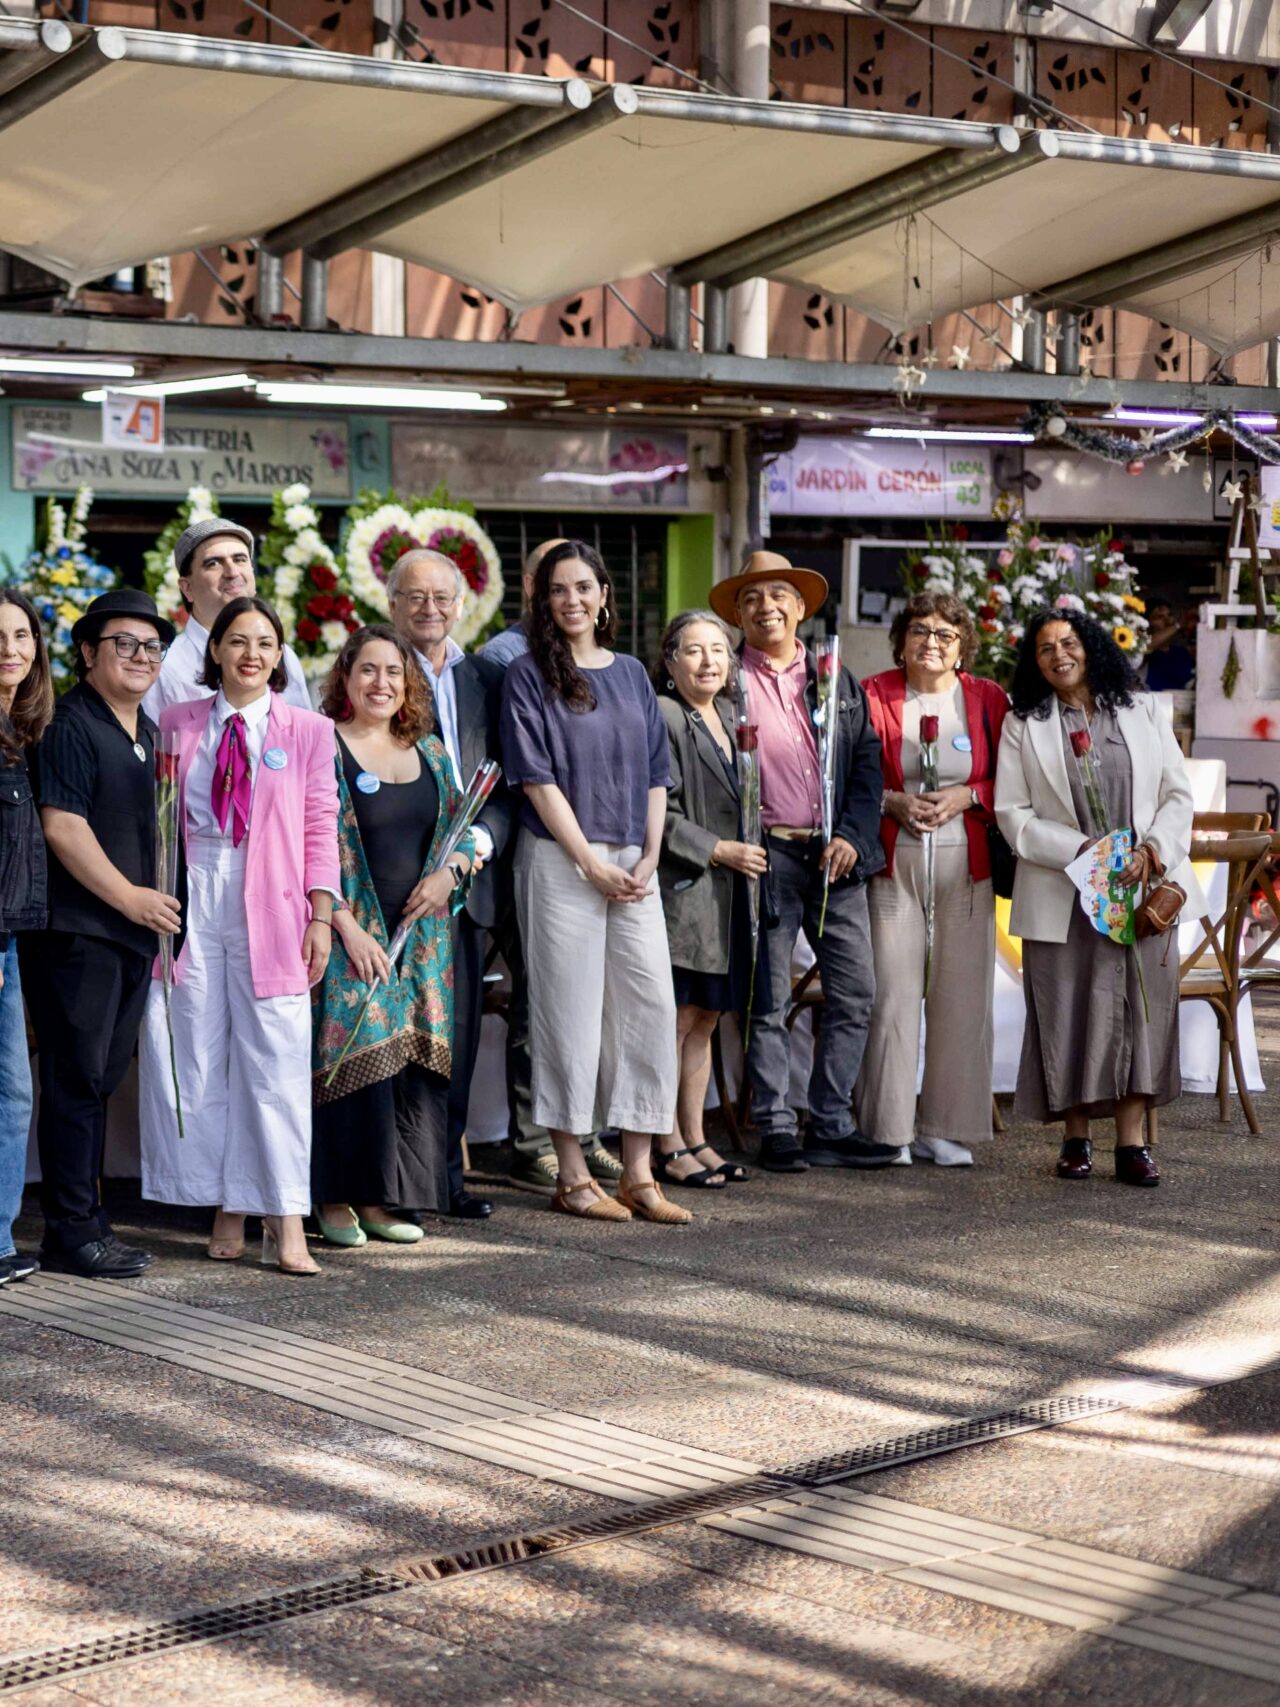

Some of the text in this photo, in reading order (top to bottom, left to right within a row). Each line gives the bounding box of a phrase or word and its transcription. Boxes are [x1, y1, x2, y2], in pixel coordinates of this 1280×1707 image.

[54, 449, 314, 488] ANA SOZA Y MARCOS
[956, 482, 981, 505] 43
